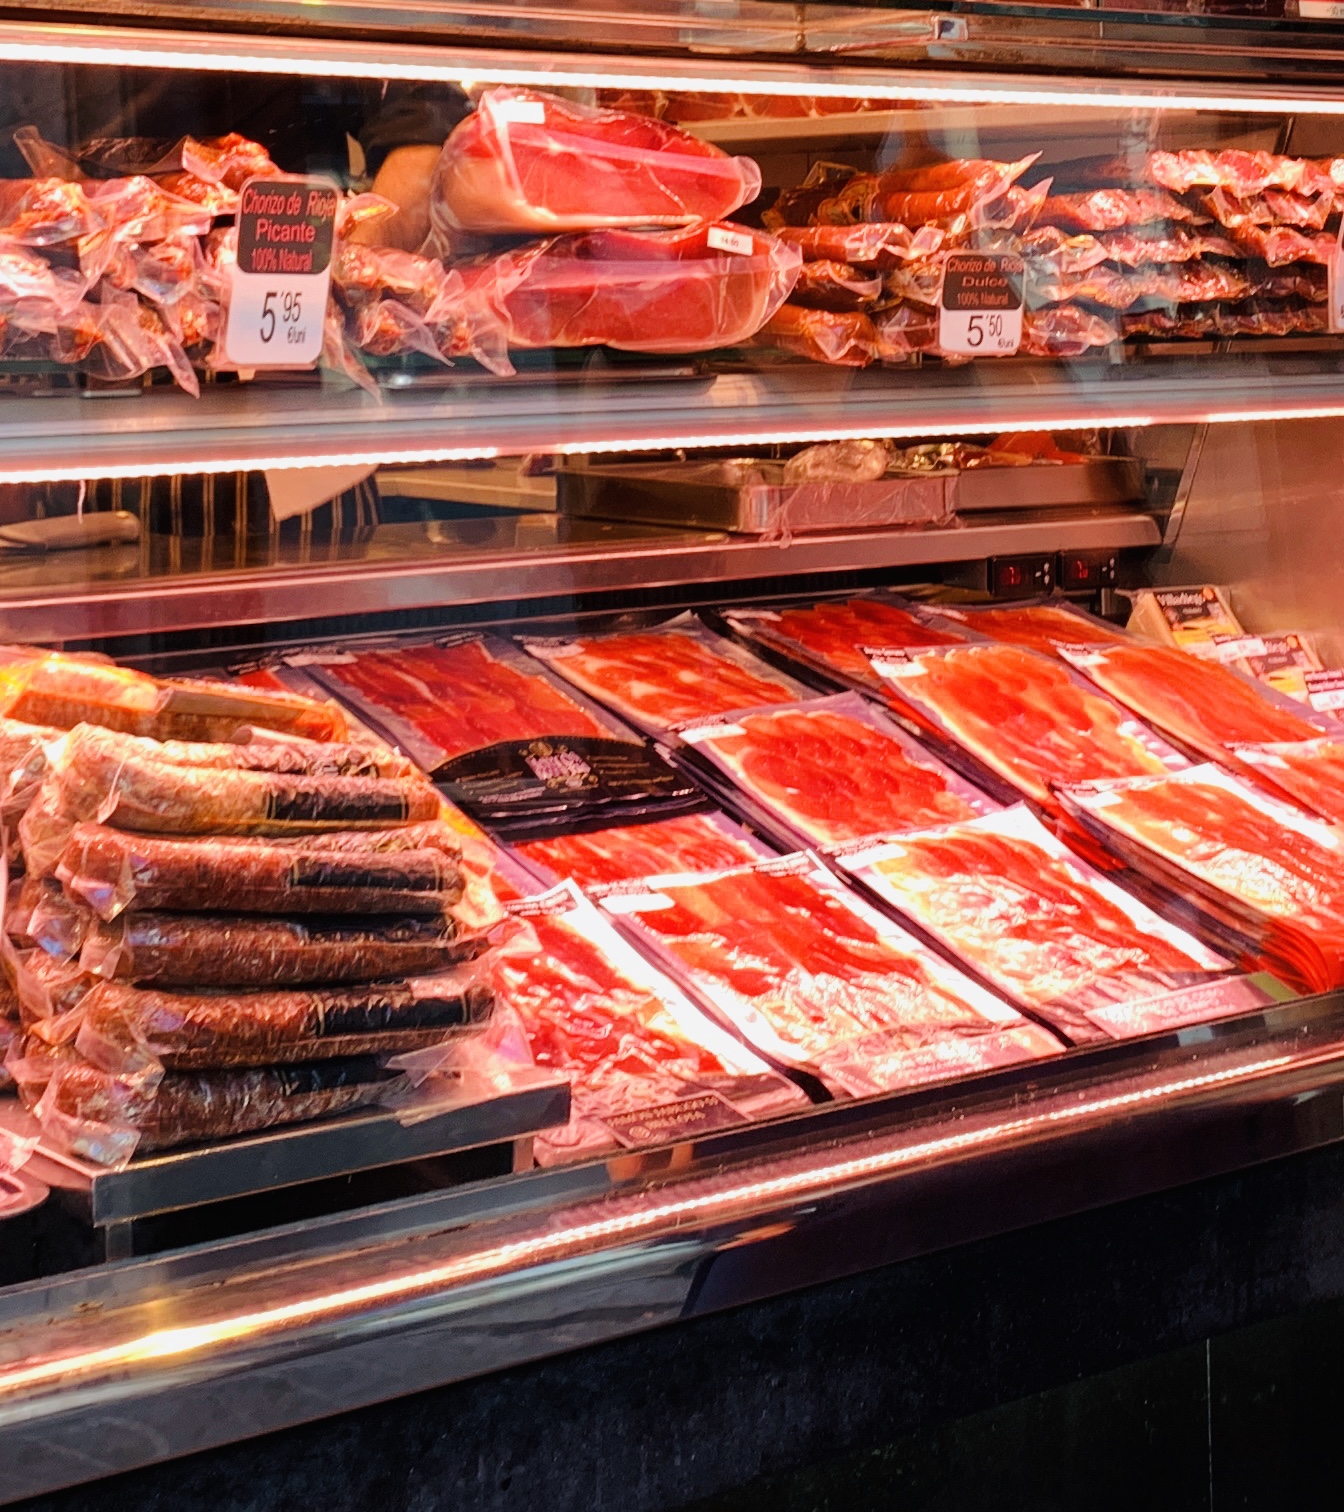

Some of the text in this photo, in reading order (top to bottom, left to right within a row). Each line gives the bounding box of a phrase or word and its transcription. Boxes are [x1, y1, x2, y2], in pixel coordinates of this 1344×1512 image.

[242, 189, 337, 223] Chorizo de Rioja
[255, 218, 316, 243] Picante
[251, 248, 313, 272] 100% Natural
[947, 257, 982, 273] Chorizo
[984, 257, 996, 273] de
[962, 276, 1009, 288] Dulce
[957, 292, 1009, 306] 100% Natural
